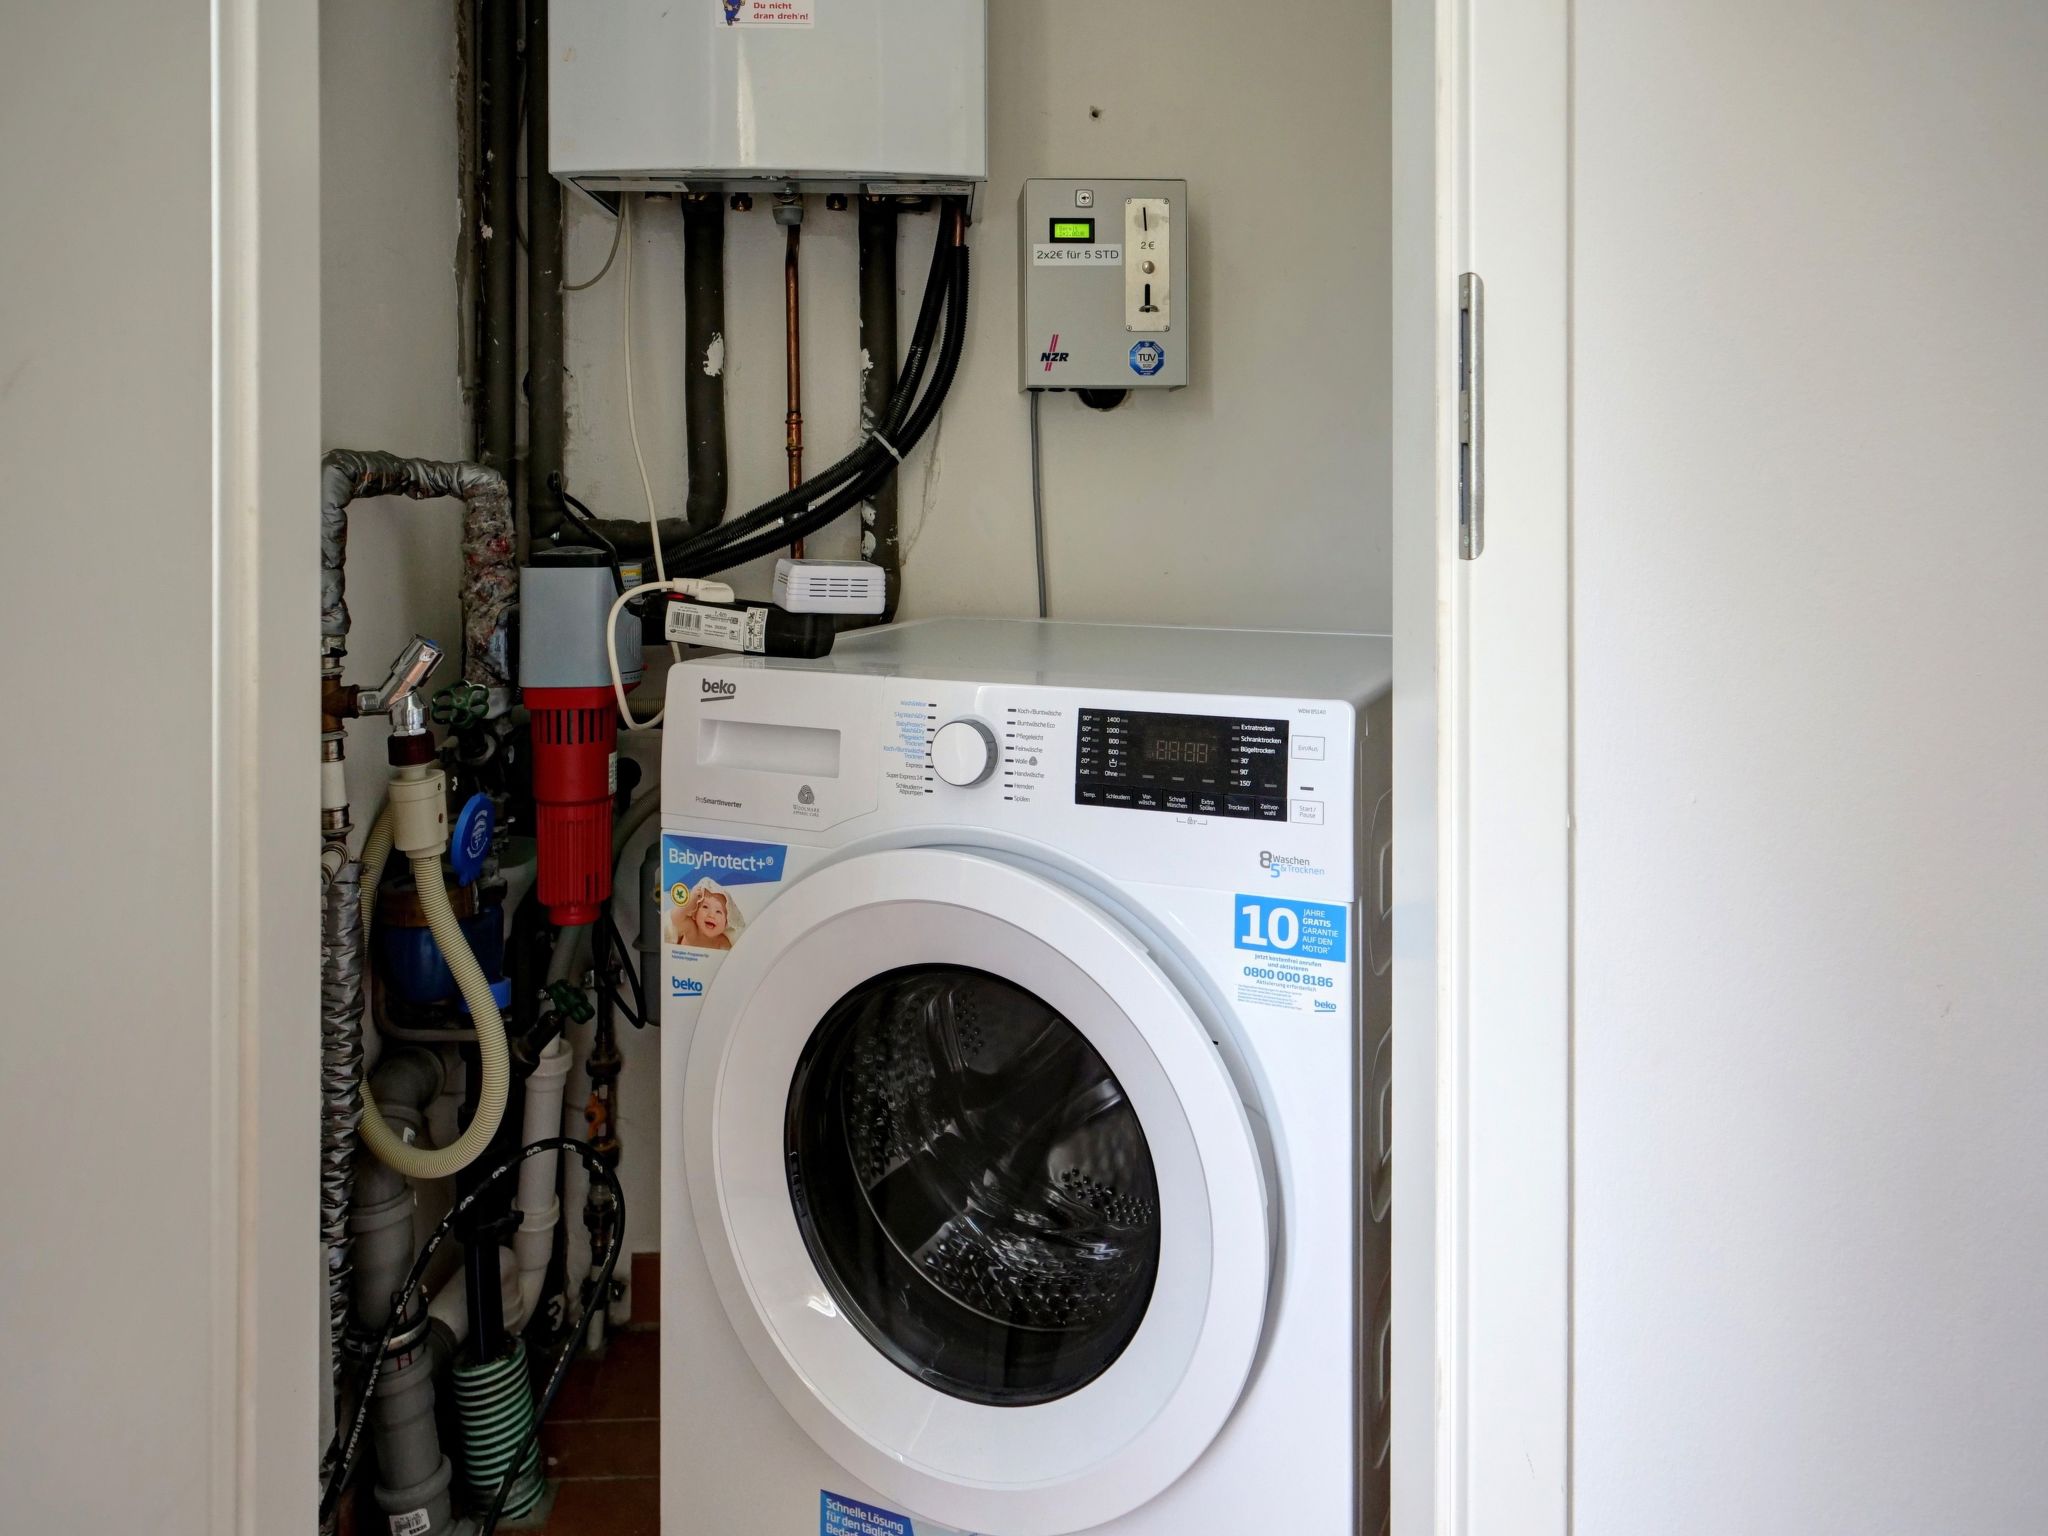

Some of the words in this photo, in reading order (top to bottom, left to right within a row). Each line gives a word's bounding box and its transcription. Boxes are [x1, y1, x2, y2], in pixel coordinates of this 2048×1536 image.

[753, 12, 774, 20] dran
[1140, 241, 1147, 249] 2
[1148, 241, 1155, 249] €
[1036, 249, 1063, 260] 2x2€
[1066, 249, 1080, 259] für
[1084, 250, 1091, 259] 5
[1094, 250, 1119, 260] STD
[1040, 352, 1070, 362] NZR
[701, 678, 737, 695] beko
[1241, 724, 1275, 732] Extratrocken
[1240, 735, 1282, 744] Schranktrocken
[905, 761, 924, 769] Express
[1105, 793, 1131, 801] Schleudern
[1227, 803, 1250, 811] Trocknen
[1260, 803, 1280, 811] Zeitvor-
[1259, 850, 1272, 869] 8
[1273, 854, 1310, 866] Waschen
[1270, 863, 1281, 878] 5
[1303, 908, 1326, 918] JAHRE
[1241, 904, 1300, 950] 10
[1302, 917, 1332, 928] GRATIS
[1302, 926, 1339, 938] GARANTIE
[1302, 935, 1317, 944] AUF
[1317, 937, 1333, 946] DEN
[1269, 955, 1298, 965] kostenfrei
[1298, 959, 1322, 968] anrufen
[1279, 963, 1309, 972] aktivieren
[1243, 966, 1275, 980] 0800
[1276, 971, 1301, 984] 000
[1302, 974, 1334, 988] 8186
[672, 975, 703, 992] beko
[1314, 1000, 1337, 1010] beko
[826, 1498, 867, 1521] Schnelle
[868, 1512, 904, 1535] Lösung
[826, 1510, 840, 1524] für
[842, 1516, 860, 1531] den
